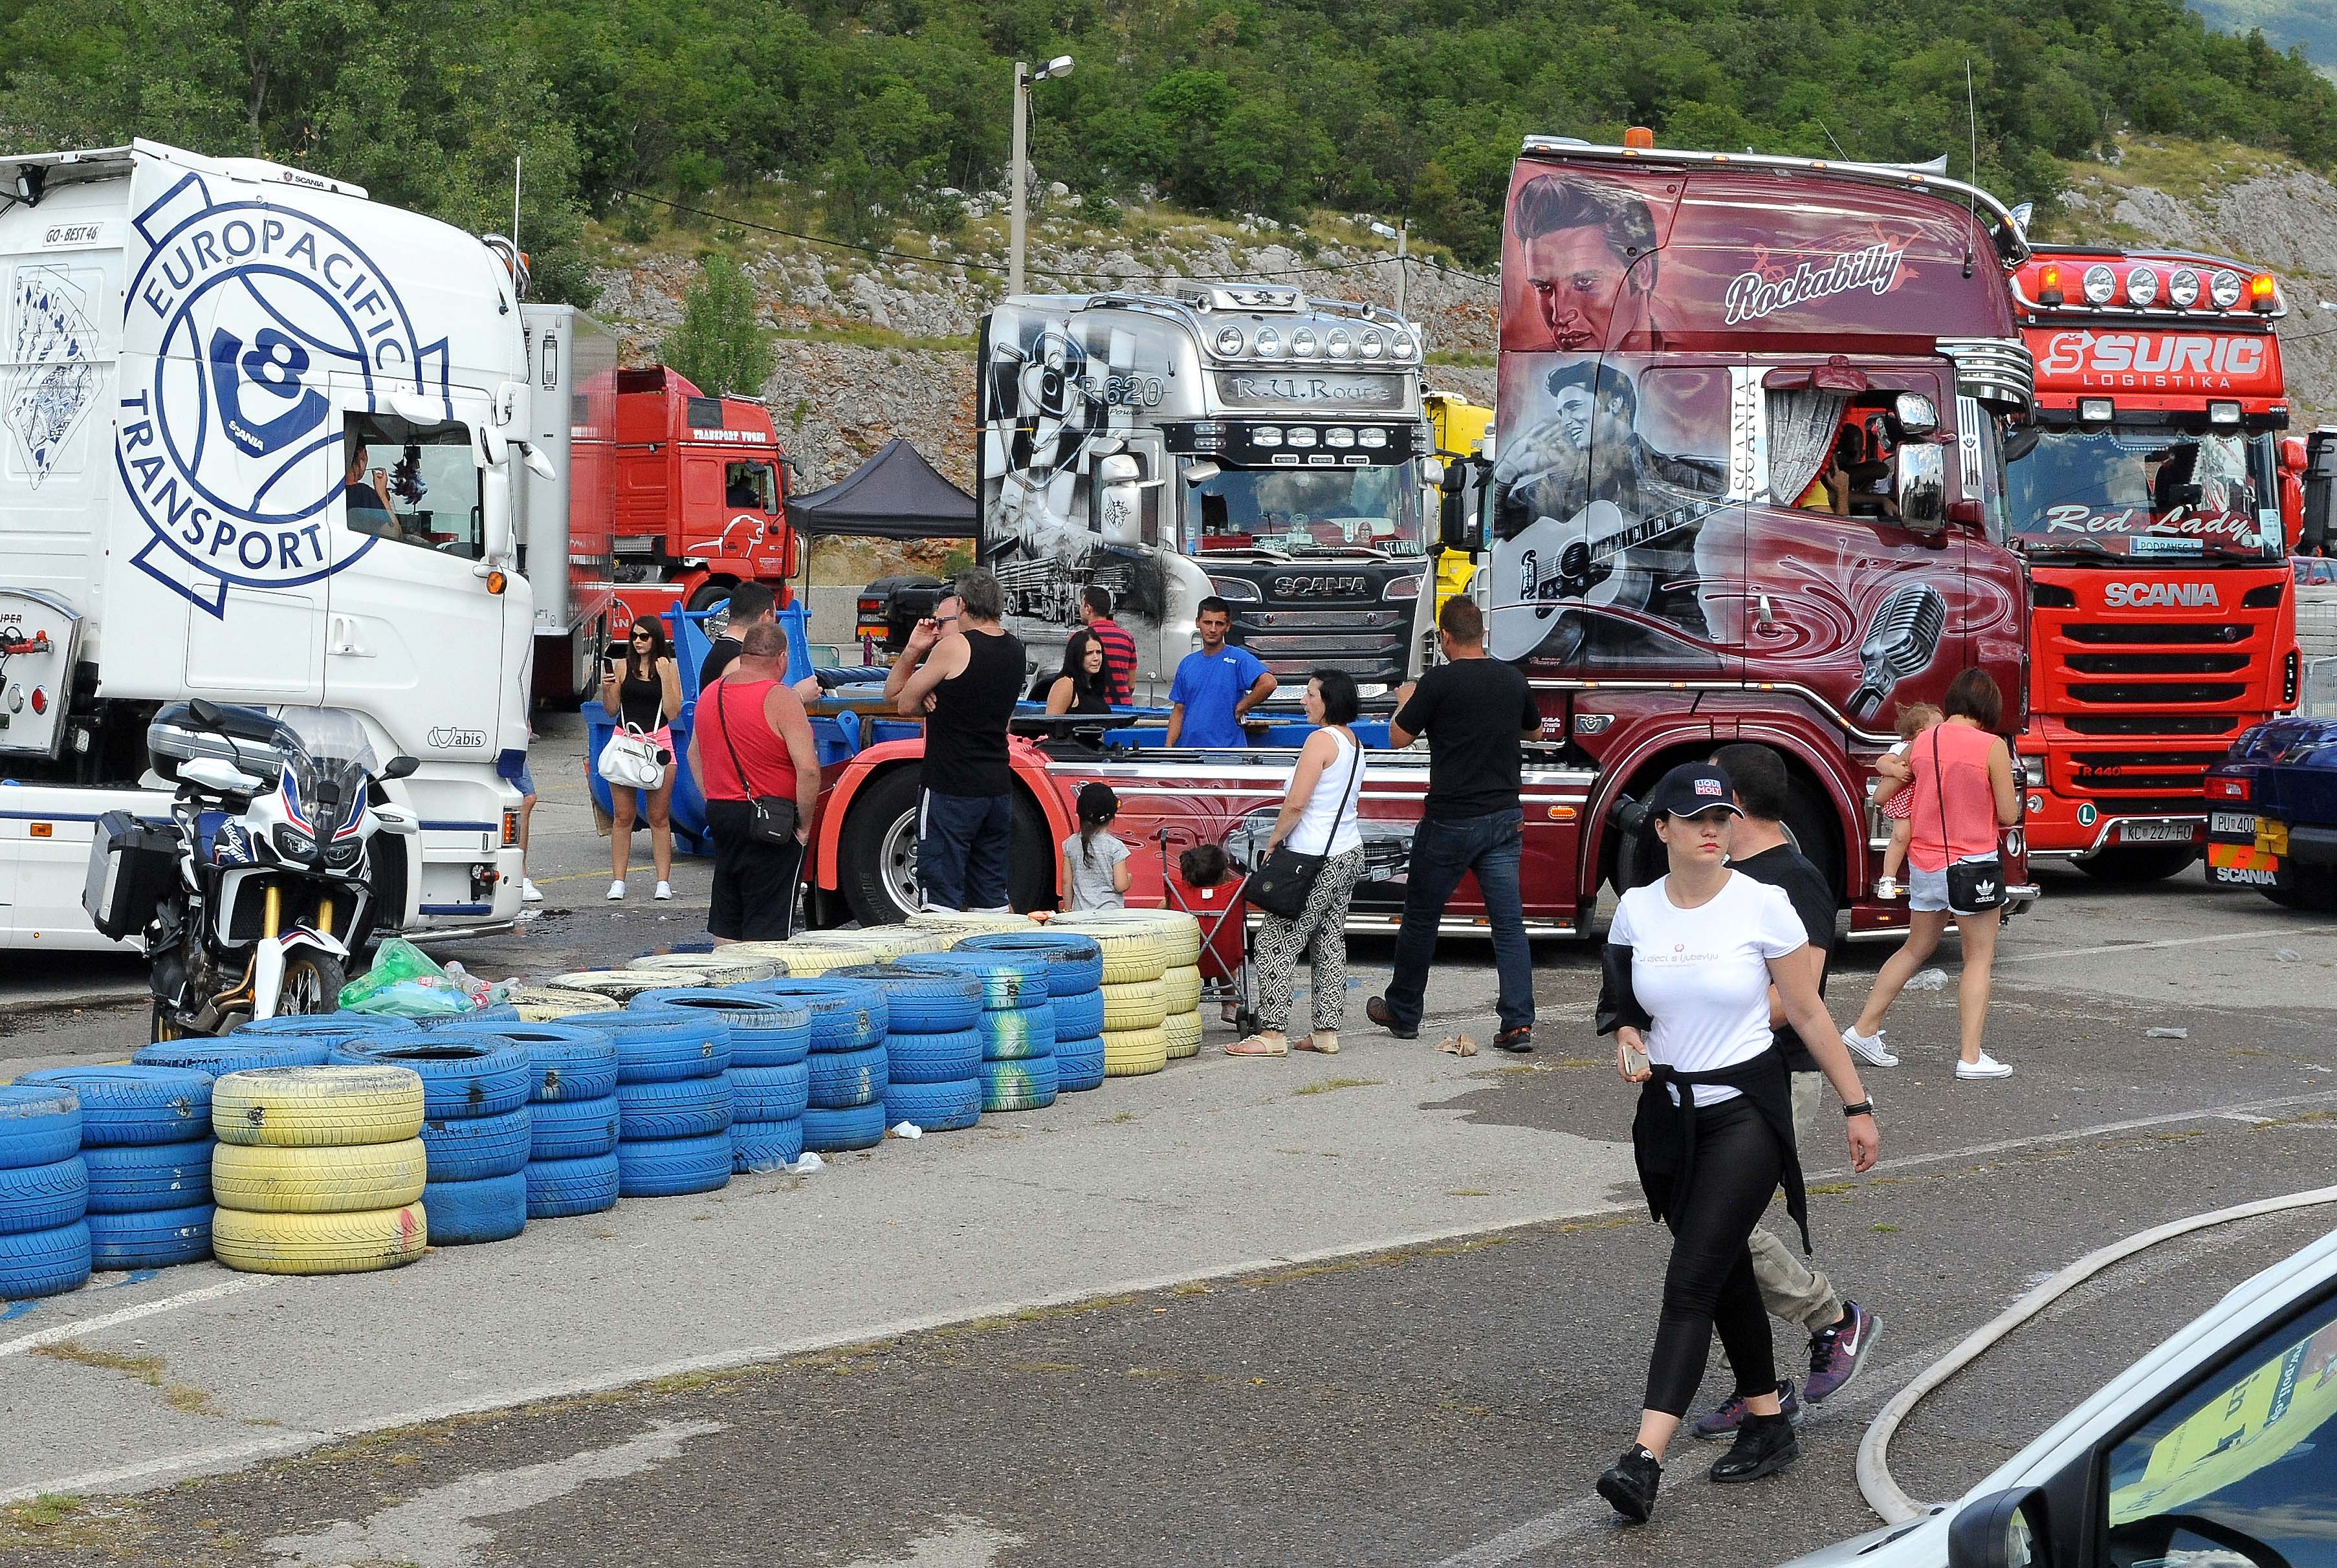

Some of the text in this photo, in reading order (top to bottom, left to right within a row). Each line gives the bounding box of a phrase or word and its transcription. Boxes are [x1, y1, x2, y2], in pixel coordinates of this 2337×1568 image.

[295, 175, 324, 188] SCANIA
[87, 226, 98, 240] 46
[1724, 242, 1904, 325] Rockabilly
[143, 220, 406, 369] EUROPACIFIC
[2083, 374, 2230, 388] LOGISTIKA
[1103, 375, 1165, 407] 620
[228, 420, 264, 452] SCANIA
[694, 430, 738, 441] TRANSPORT
[121, 389, 324, 570] TRANSPORT
[2047, 505, 2252, 541] Red Lady
[1275, 576, 1368, 596] SCANIA
[2105, 583, 2219, 607] SCANIA
[2083, 767, 2121, 776] R 440
[1698, 786, 1720, 794] MOLY
[2082, 807, 2092, 823] L
[2218, 816, 2230, 831] PU
[2127, 826, 2142, 840] KC
[2217, 867, 2277, 886] SCANIA
